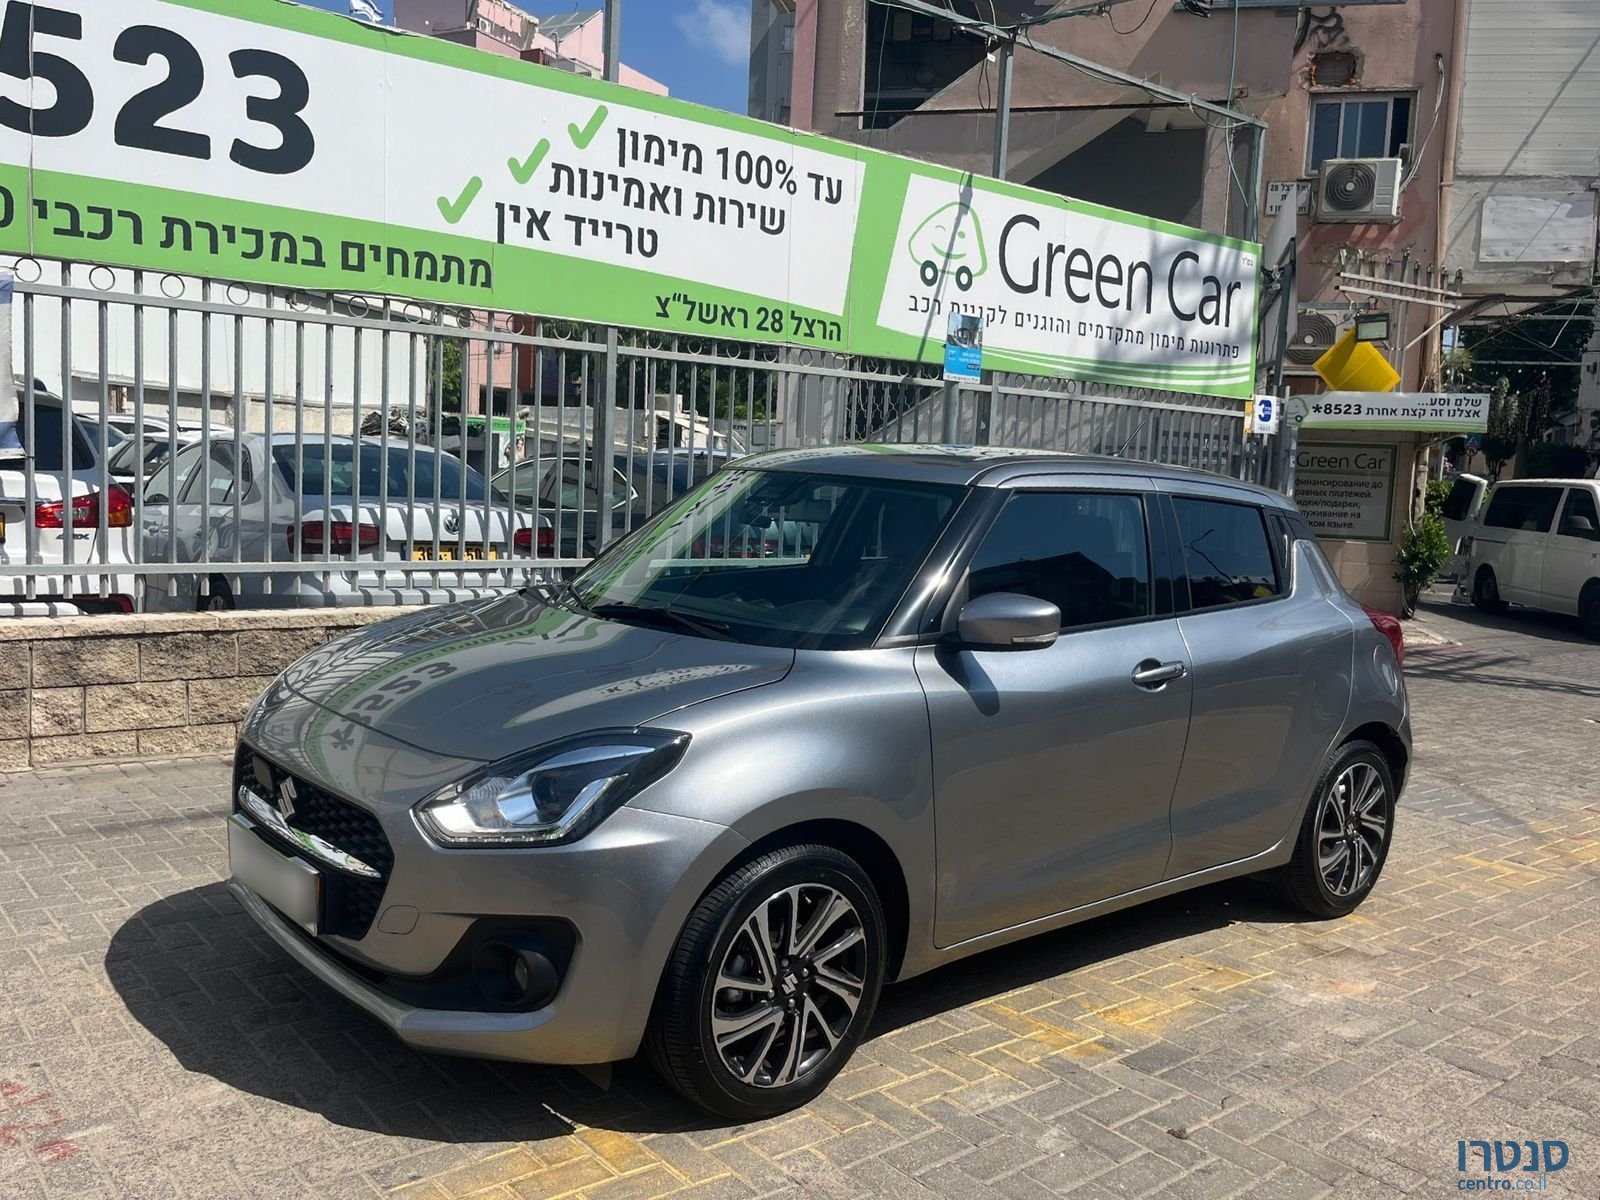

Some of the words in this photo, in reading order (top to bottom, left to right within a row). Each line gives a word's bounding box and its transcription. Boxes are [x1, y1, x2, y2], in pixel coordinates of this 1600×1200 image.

[617, 127, 702, 174] מימון
[716, 147, 797, 195] 100%
[549, 162, 682, 216] ואמינות
[807, 171, 842, 205] עד
[32, 198, 143, 245] רכבי
[495, 202, 551, 244] אין
[693, 191, 785, 235] שירות
[160, 216, 326, 268] במכירת
[564, 213, 658, 258] טרייד
[341, 241, 492, 289] מתמחים
[999, 214, 1153, 314] Green
[1168, 251, 1241, 328] Car
[756, 306, 784, 333] 28
[908, 295, 942, 315] רכב
[790, 310, 842, 342] הרצל
[1014, 312, 1071, 335] והוגנים
[1078, 322, 1144, 345] מתקדמים
[1150, 331, 1185, 351] מימון
[1189, 339, 1240, 360] פתרונות
[1365, 407, 1398, 417] אחרת
[1401, 407, 1426, 419] קצת
[1430, 408, 1445, 417] זה
[1447, 407, 1481, 418] אצלנו
[1454, 396, 1482, 407] שלם
[1296, 451, 1350, 469] Green
[1354, 453, 1385, 470] Car
